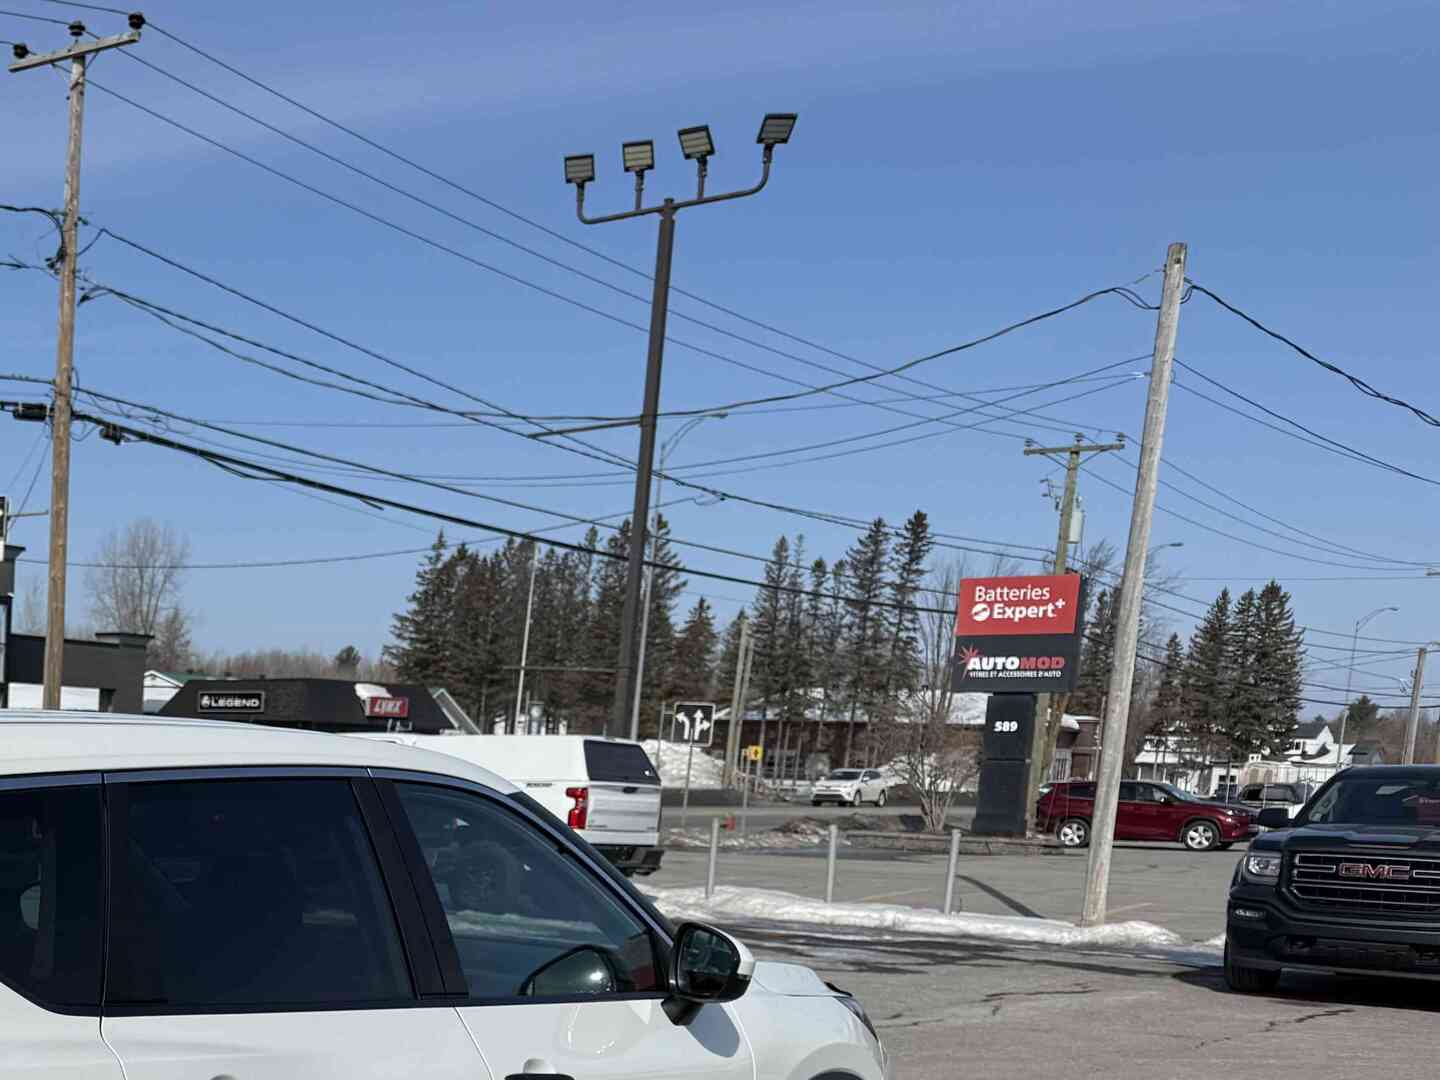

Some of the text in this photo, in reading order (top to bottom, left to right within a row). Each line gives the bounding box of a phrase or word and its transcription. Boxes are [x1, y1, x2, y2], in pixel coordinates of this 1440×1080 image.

[975, 584, 1051, 602] Batteries
[967, 656, 1065, 670] AUTOMOD
[211, 695, 260, 708] LEGEND
[993, 720, 1018, 732] 589
[1339, 862, 1410, 880] GMC
